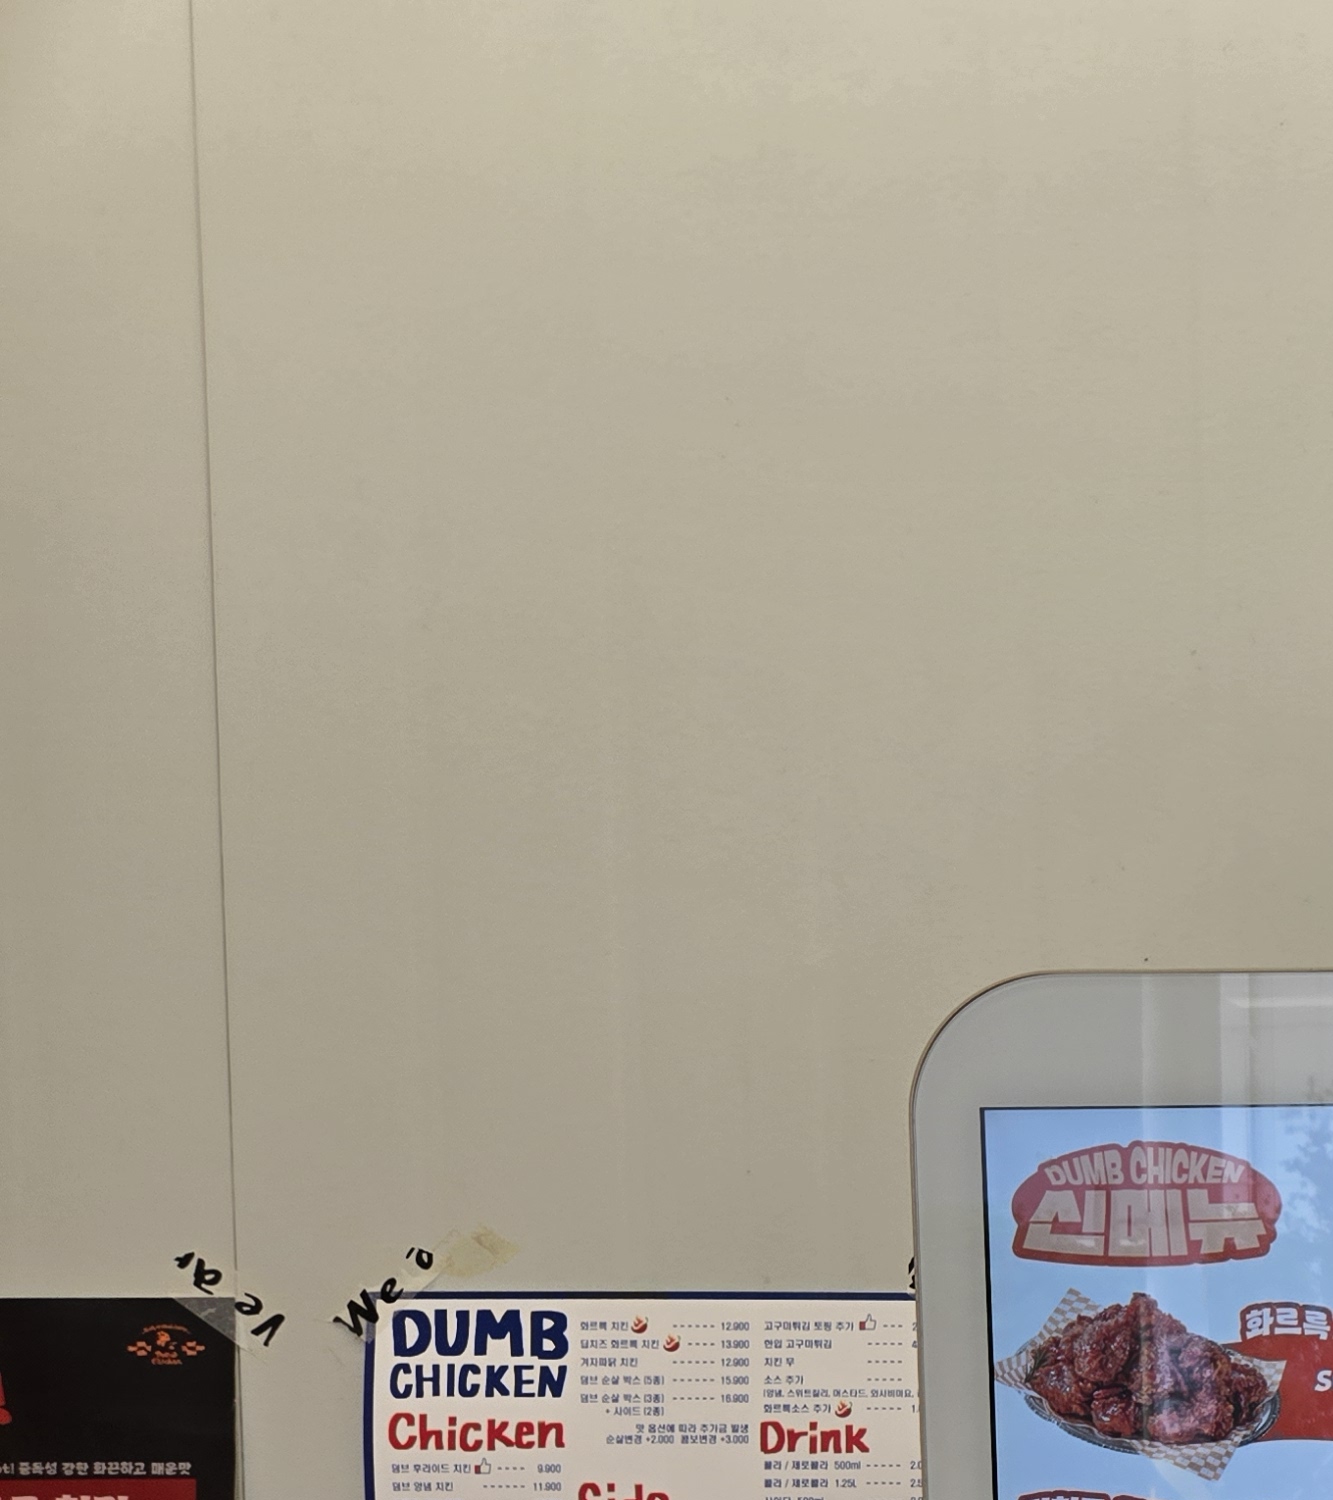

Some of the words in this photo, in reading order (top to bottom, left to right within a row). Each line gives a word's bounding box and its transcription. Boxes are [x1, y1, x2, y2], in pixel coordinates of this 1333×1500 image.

[1045, 1150, 1124, 1186] DUMB
[1130, 1147, 1246, 1184] CHICKEN
[1022, 1188, 1266, 1257] 신메뉴
[392, 1309, 569, 1360] DUMB
[1246, 1309, 1331, 1340] 화르륵
[389, 1364, 567, 1400] CHICKEN
[388, 1413, 566, 1451] Chicken
[760, 1421, 870, 1454] Drink
